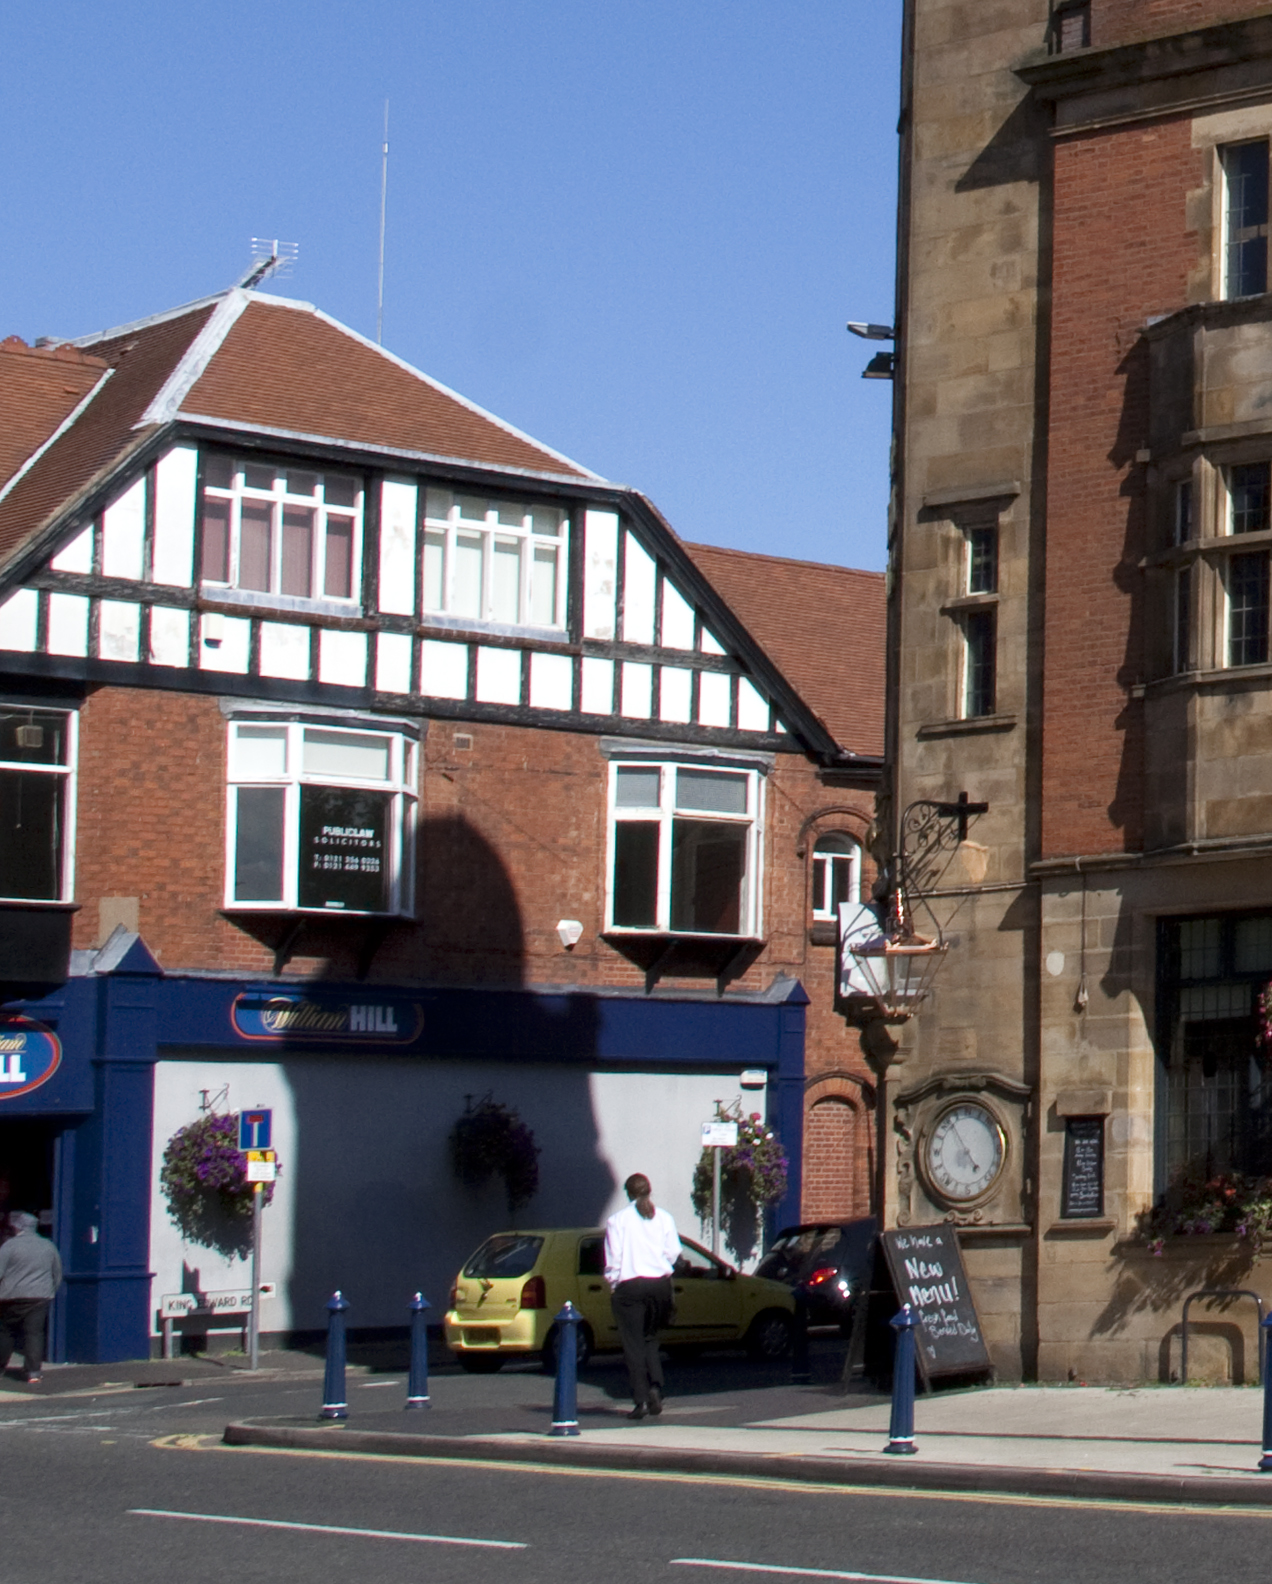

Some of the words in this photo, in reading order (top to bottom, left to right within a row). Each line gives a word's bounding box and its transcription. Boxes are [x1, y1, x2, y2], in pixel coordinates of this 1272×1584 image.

[313, 836, 382, 848] SOLICITORS
[351, 1005, 398, 1032] HILL
[895, 1236, 910, 1250] We
[909, 1234, 933, 1249] have
[935, 1236, 944, 1246] a
[904, 1257, 944, 1280] New
[909, 1276, 960, 1307] Menu!
[168, 1299, 195, 1311] KING
[197, 1296, 237, 1310] EDWARD
